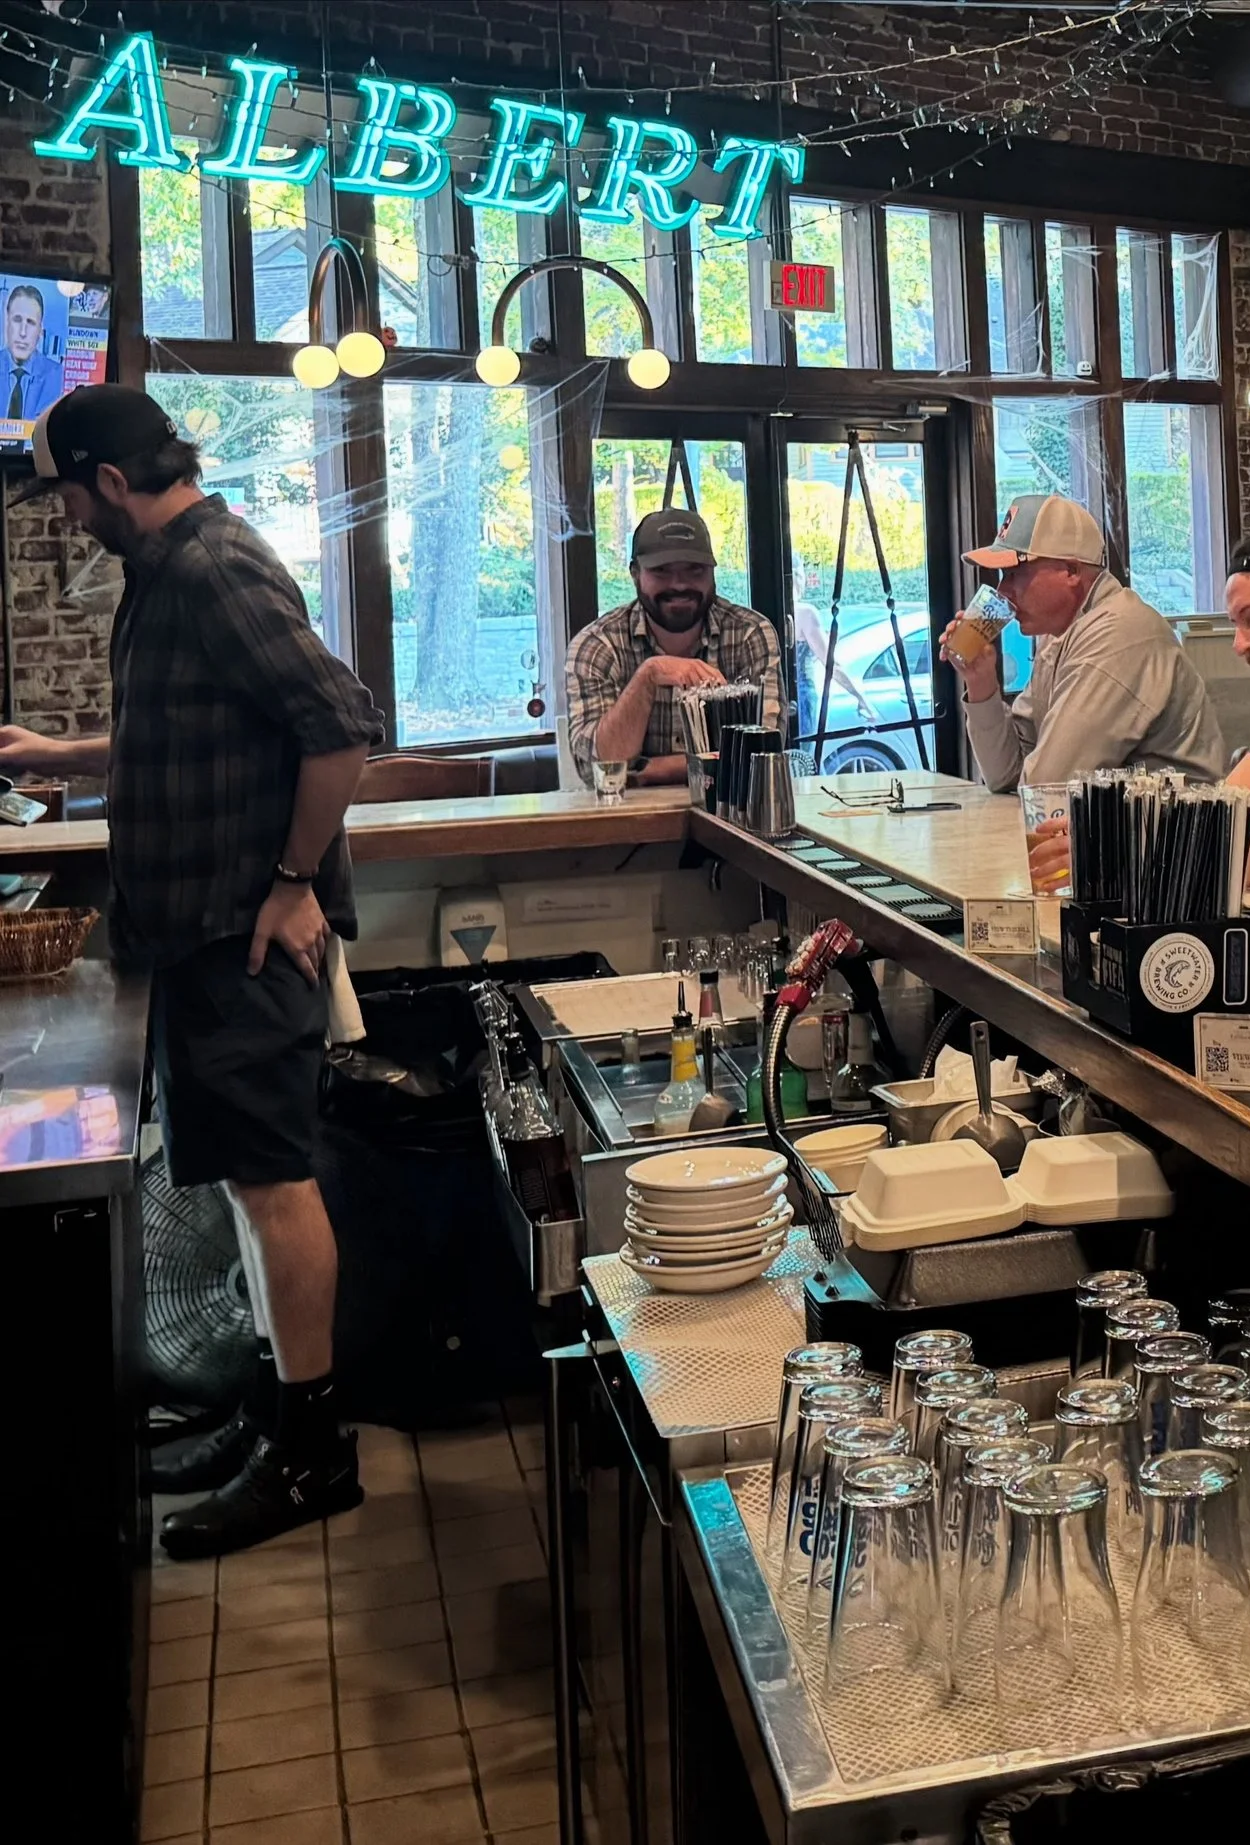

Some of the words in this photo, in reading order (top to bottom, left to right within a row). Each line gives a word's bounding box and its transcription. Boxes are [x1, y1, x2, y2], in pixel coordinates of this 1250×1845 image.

[34, 31, 805, 239] ALBERT
[782, 264, 827, 309] EXIT
[1153, 966, 1176, 1000] BREWING
[1177, 988, 1189, 999] CO
[1165, 946, 1202, 981] SWEETWATER
